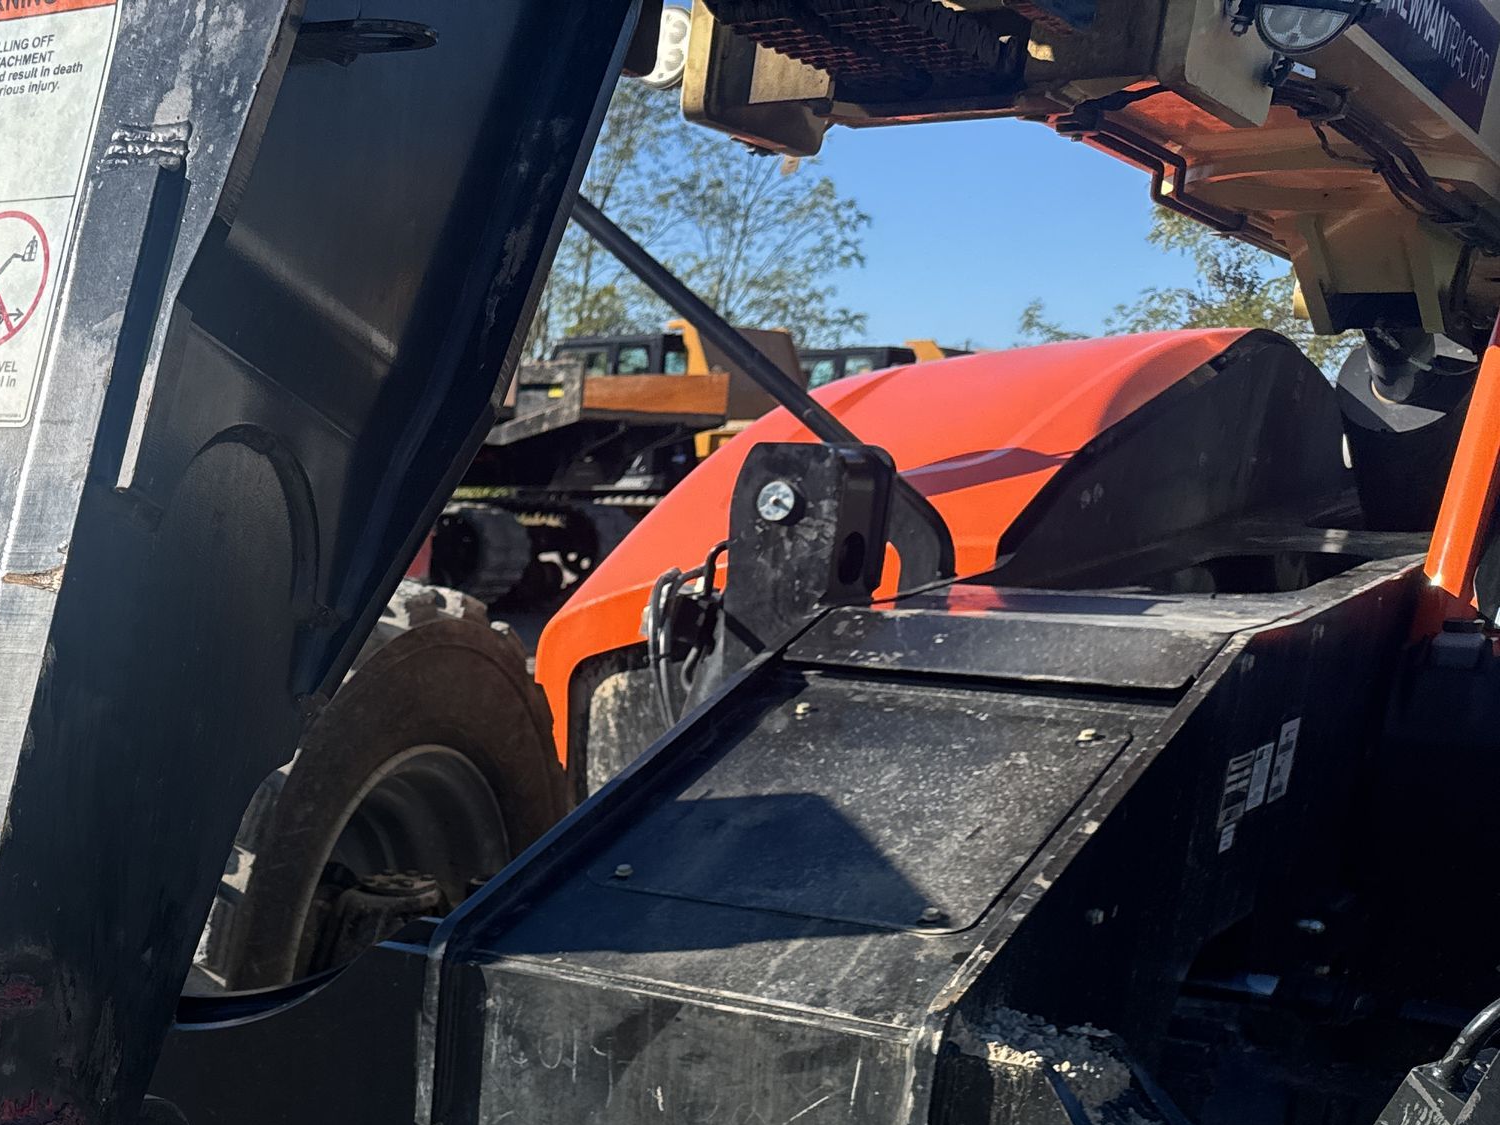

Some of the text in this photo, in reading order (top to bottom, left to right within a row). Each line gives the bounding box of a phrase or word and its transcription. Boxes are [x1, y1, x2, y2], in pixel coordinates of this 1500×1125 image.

[32, 34, 55, 48] OFF
[8, 67, 38, 81] result
[40, 65, 50, 77] in
[53, 61, 83, 76] death
[28, 80, 60, 95] injury.
[6, 376, 16, 387] in
